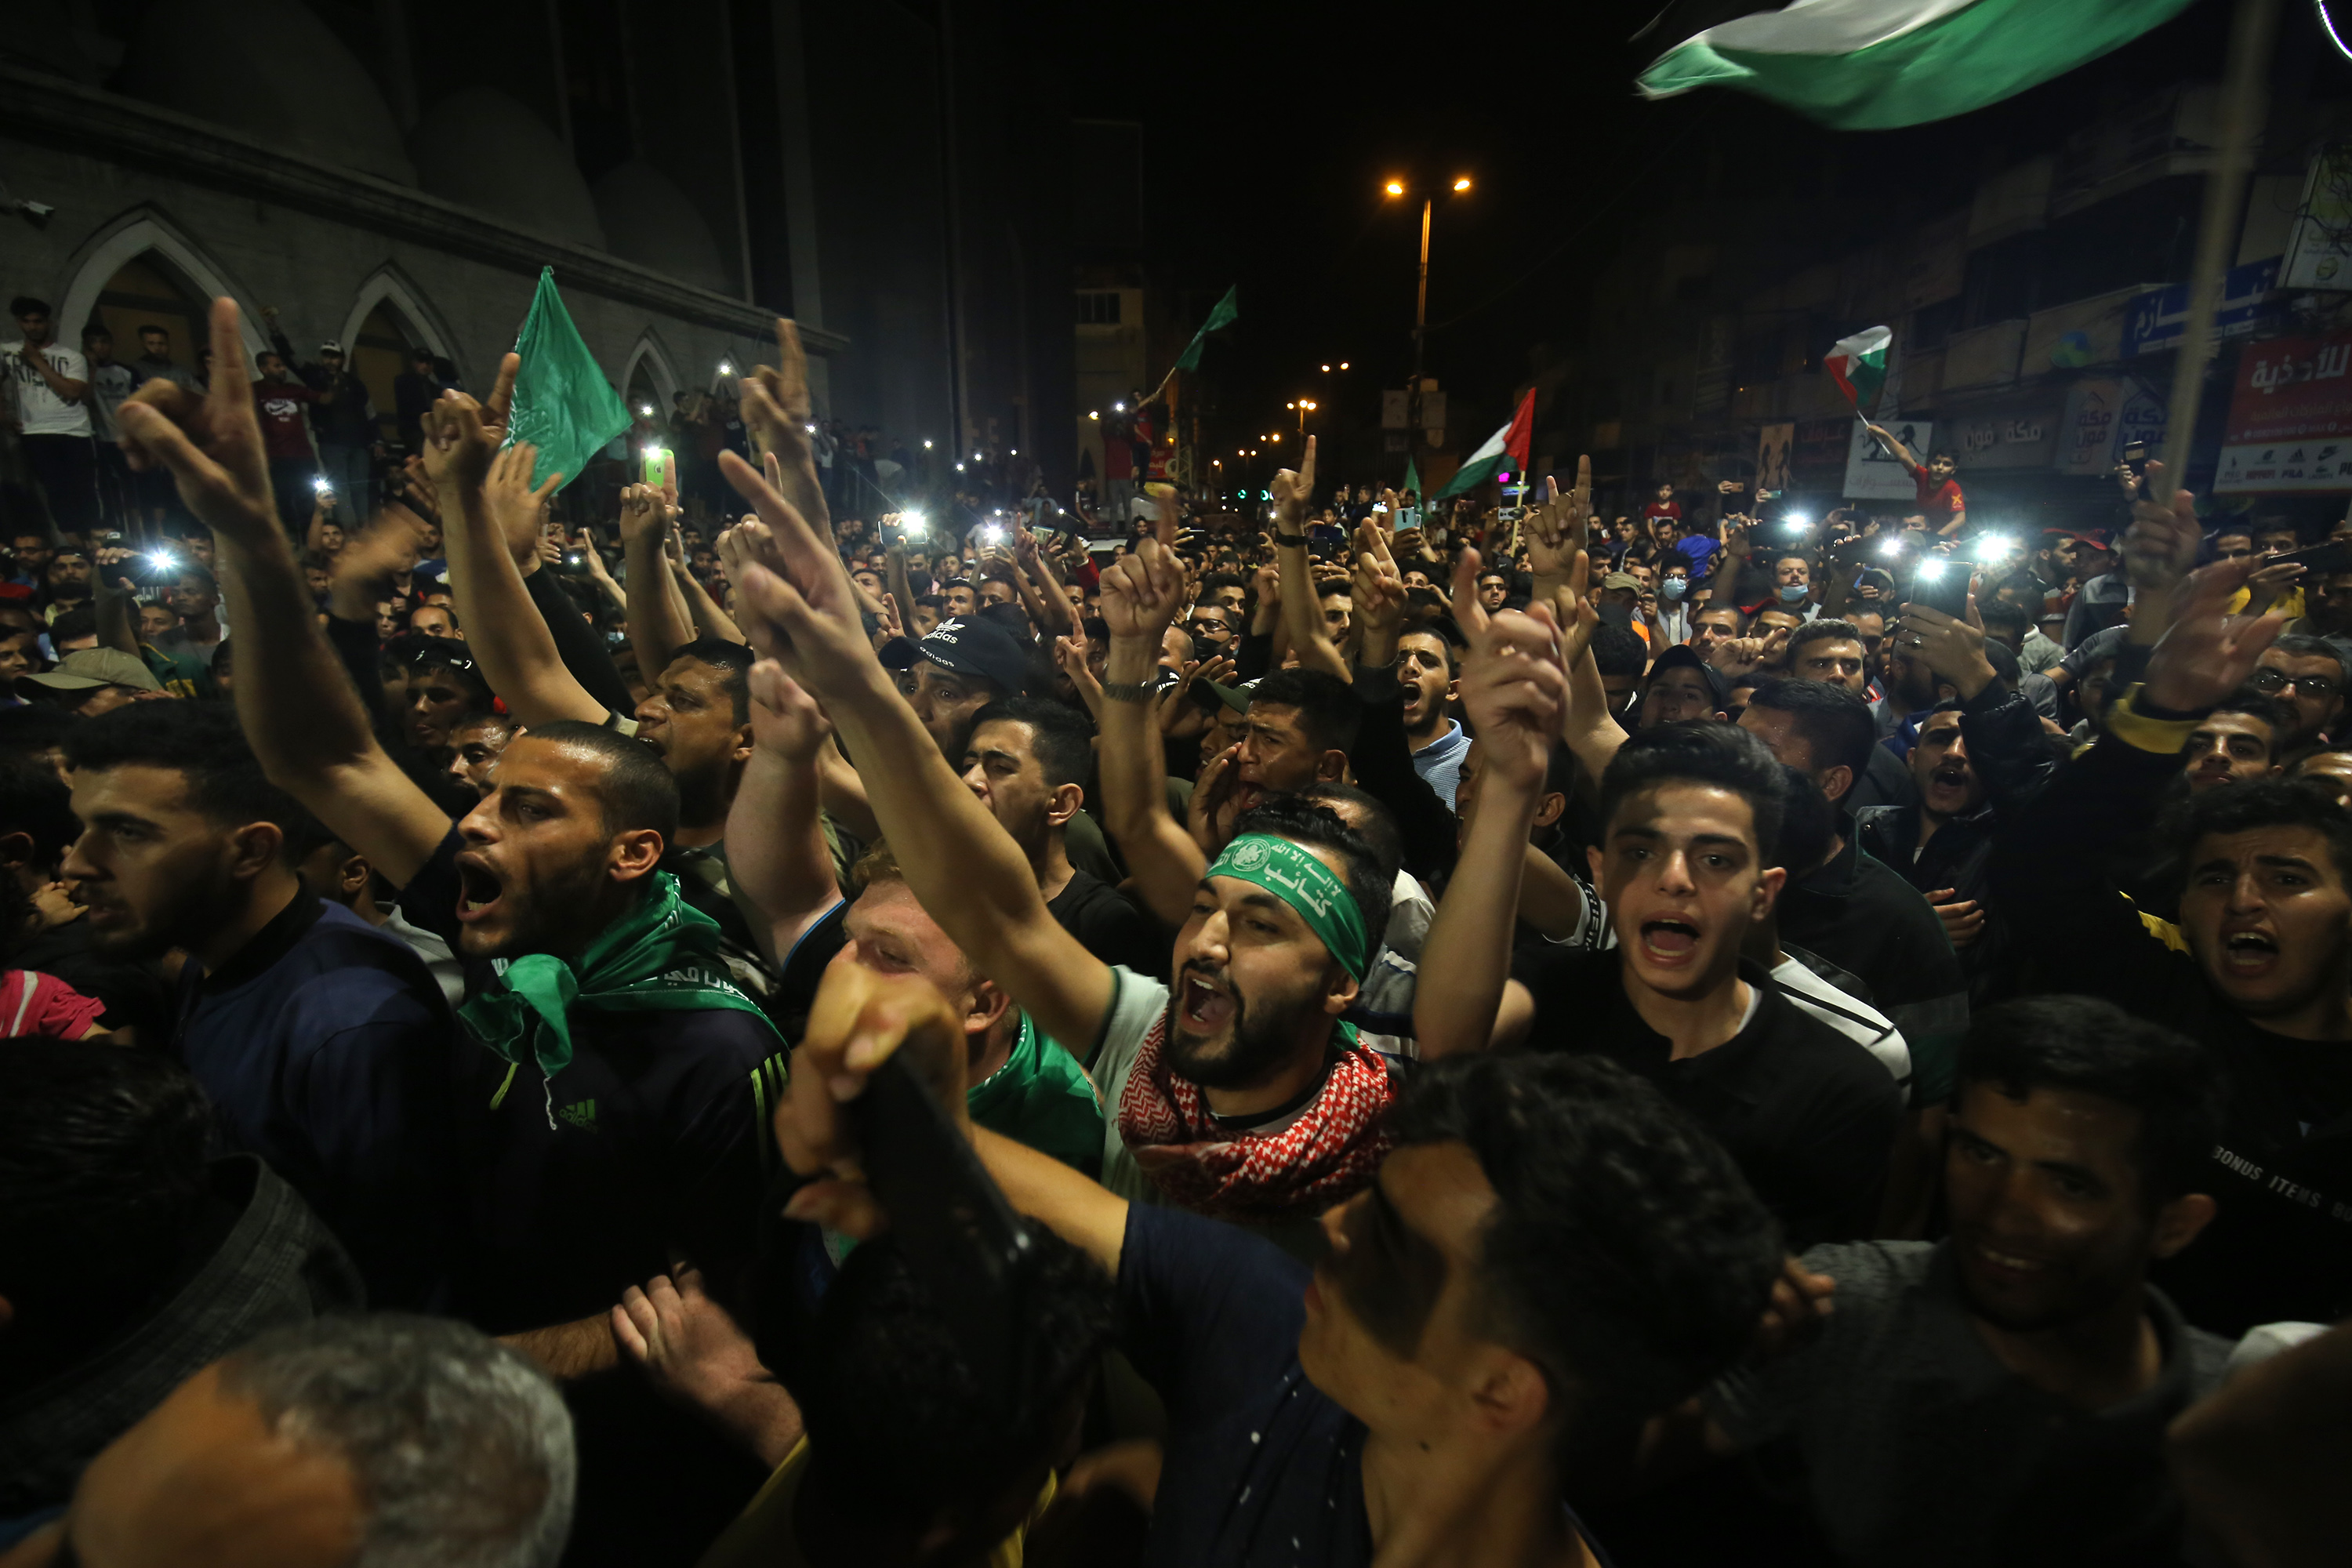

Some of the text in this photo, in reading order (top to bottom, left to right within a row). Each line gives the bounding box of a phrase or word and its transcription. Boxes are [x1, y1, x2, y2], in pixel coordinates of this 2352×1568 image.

[2078, 408, 2111, 426] مكة
[2005, 419, 2042, 442] مكة
[2281, 468, 2303, 479] FILA
[919, 646, 955, 667] adidas
[1264, 862, 1333, 919] كتائب
[559, 1108, 600, 1135] adidas
[2212, 1145, 2264, 1181] BONUS
[2267, 1175, 2322, 1208] ITEMS
